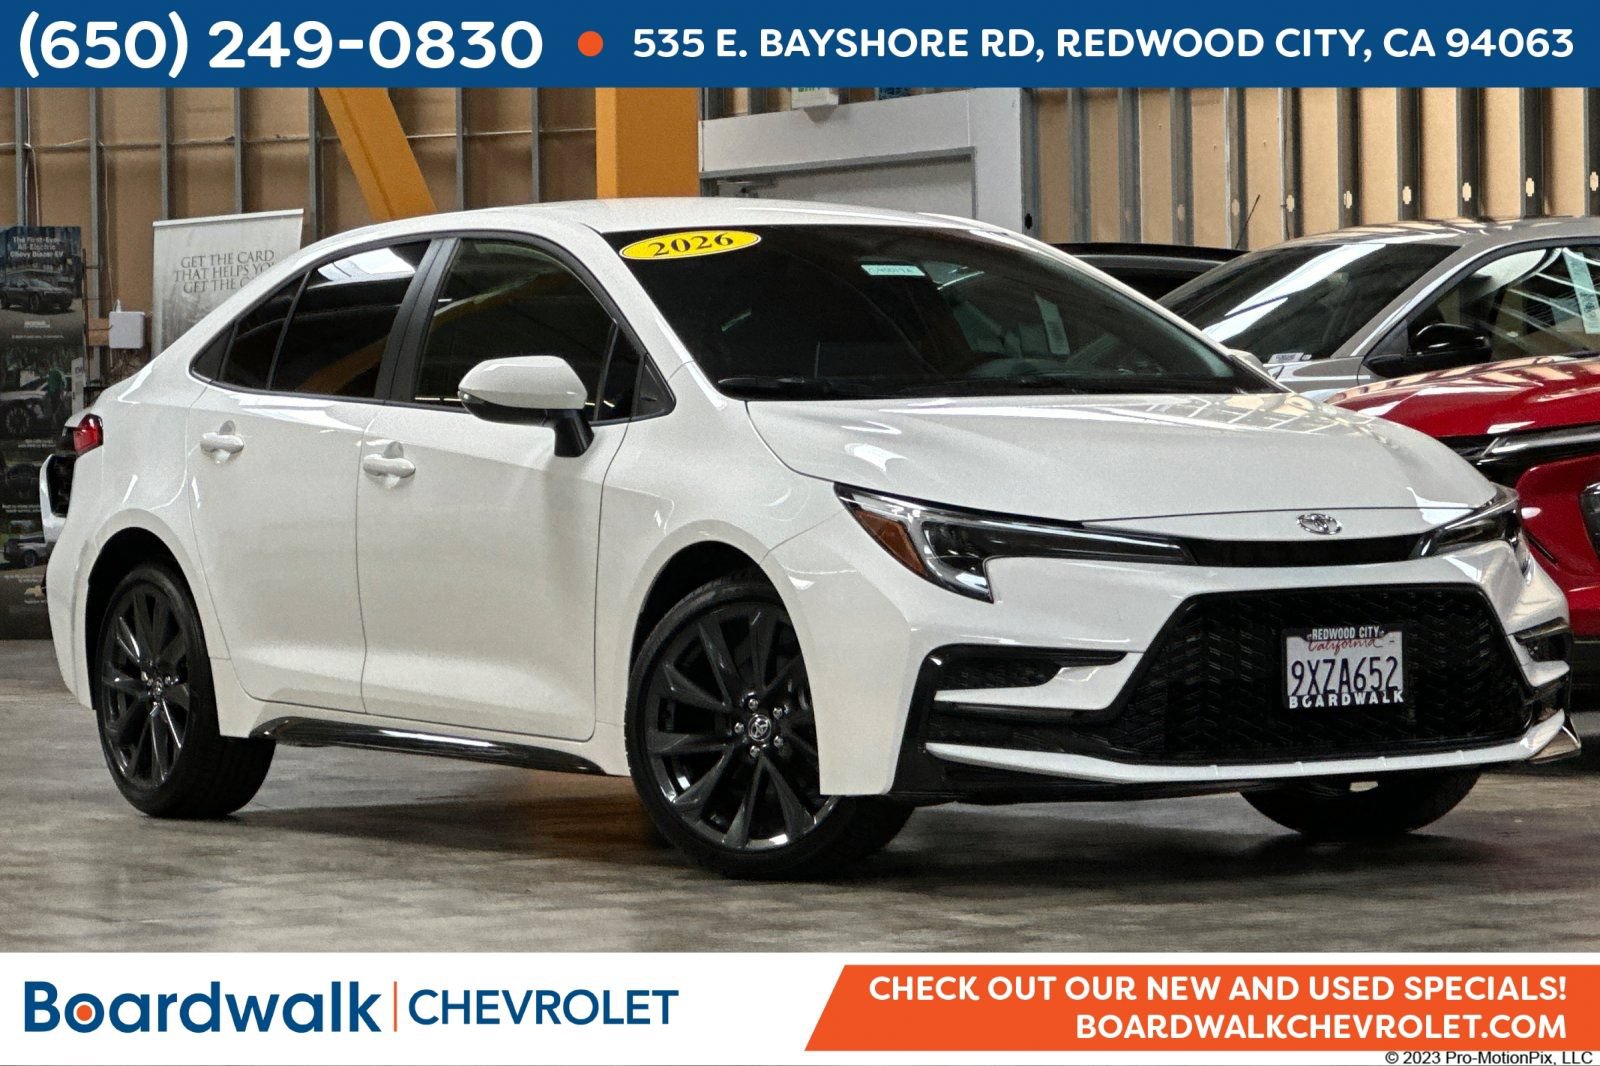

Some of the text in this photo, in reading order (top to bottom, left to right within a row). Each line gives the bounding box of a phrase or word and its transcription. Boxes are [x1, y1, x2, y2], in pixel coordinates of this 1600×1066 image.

[648, 232, 734, 257] 2026
[181, 249, 275, 268] GET THE CARD
[174, 268, 209, 282] THAT
[212, 265, 249, 279] HELPS
[183, 281, 208, 293] GET
[210, 279, 237, 292] THE
[1312, 626, 1381, 640] REDWOOD CITY
[1308, 638, 1384, 655] California
[1291, 656, 1399, 696] 9XZA652
[1289, 690, 1404, 709] BOARDWALK
